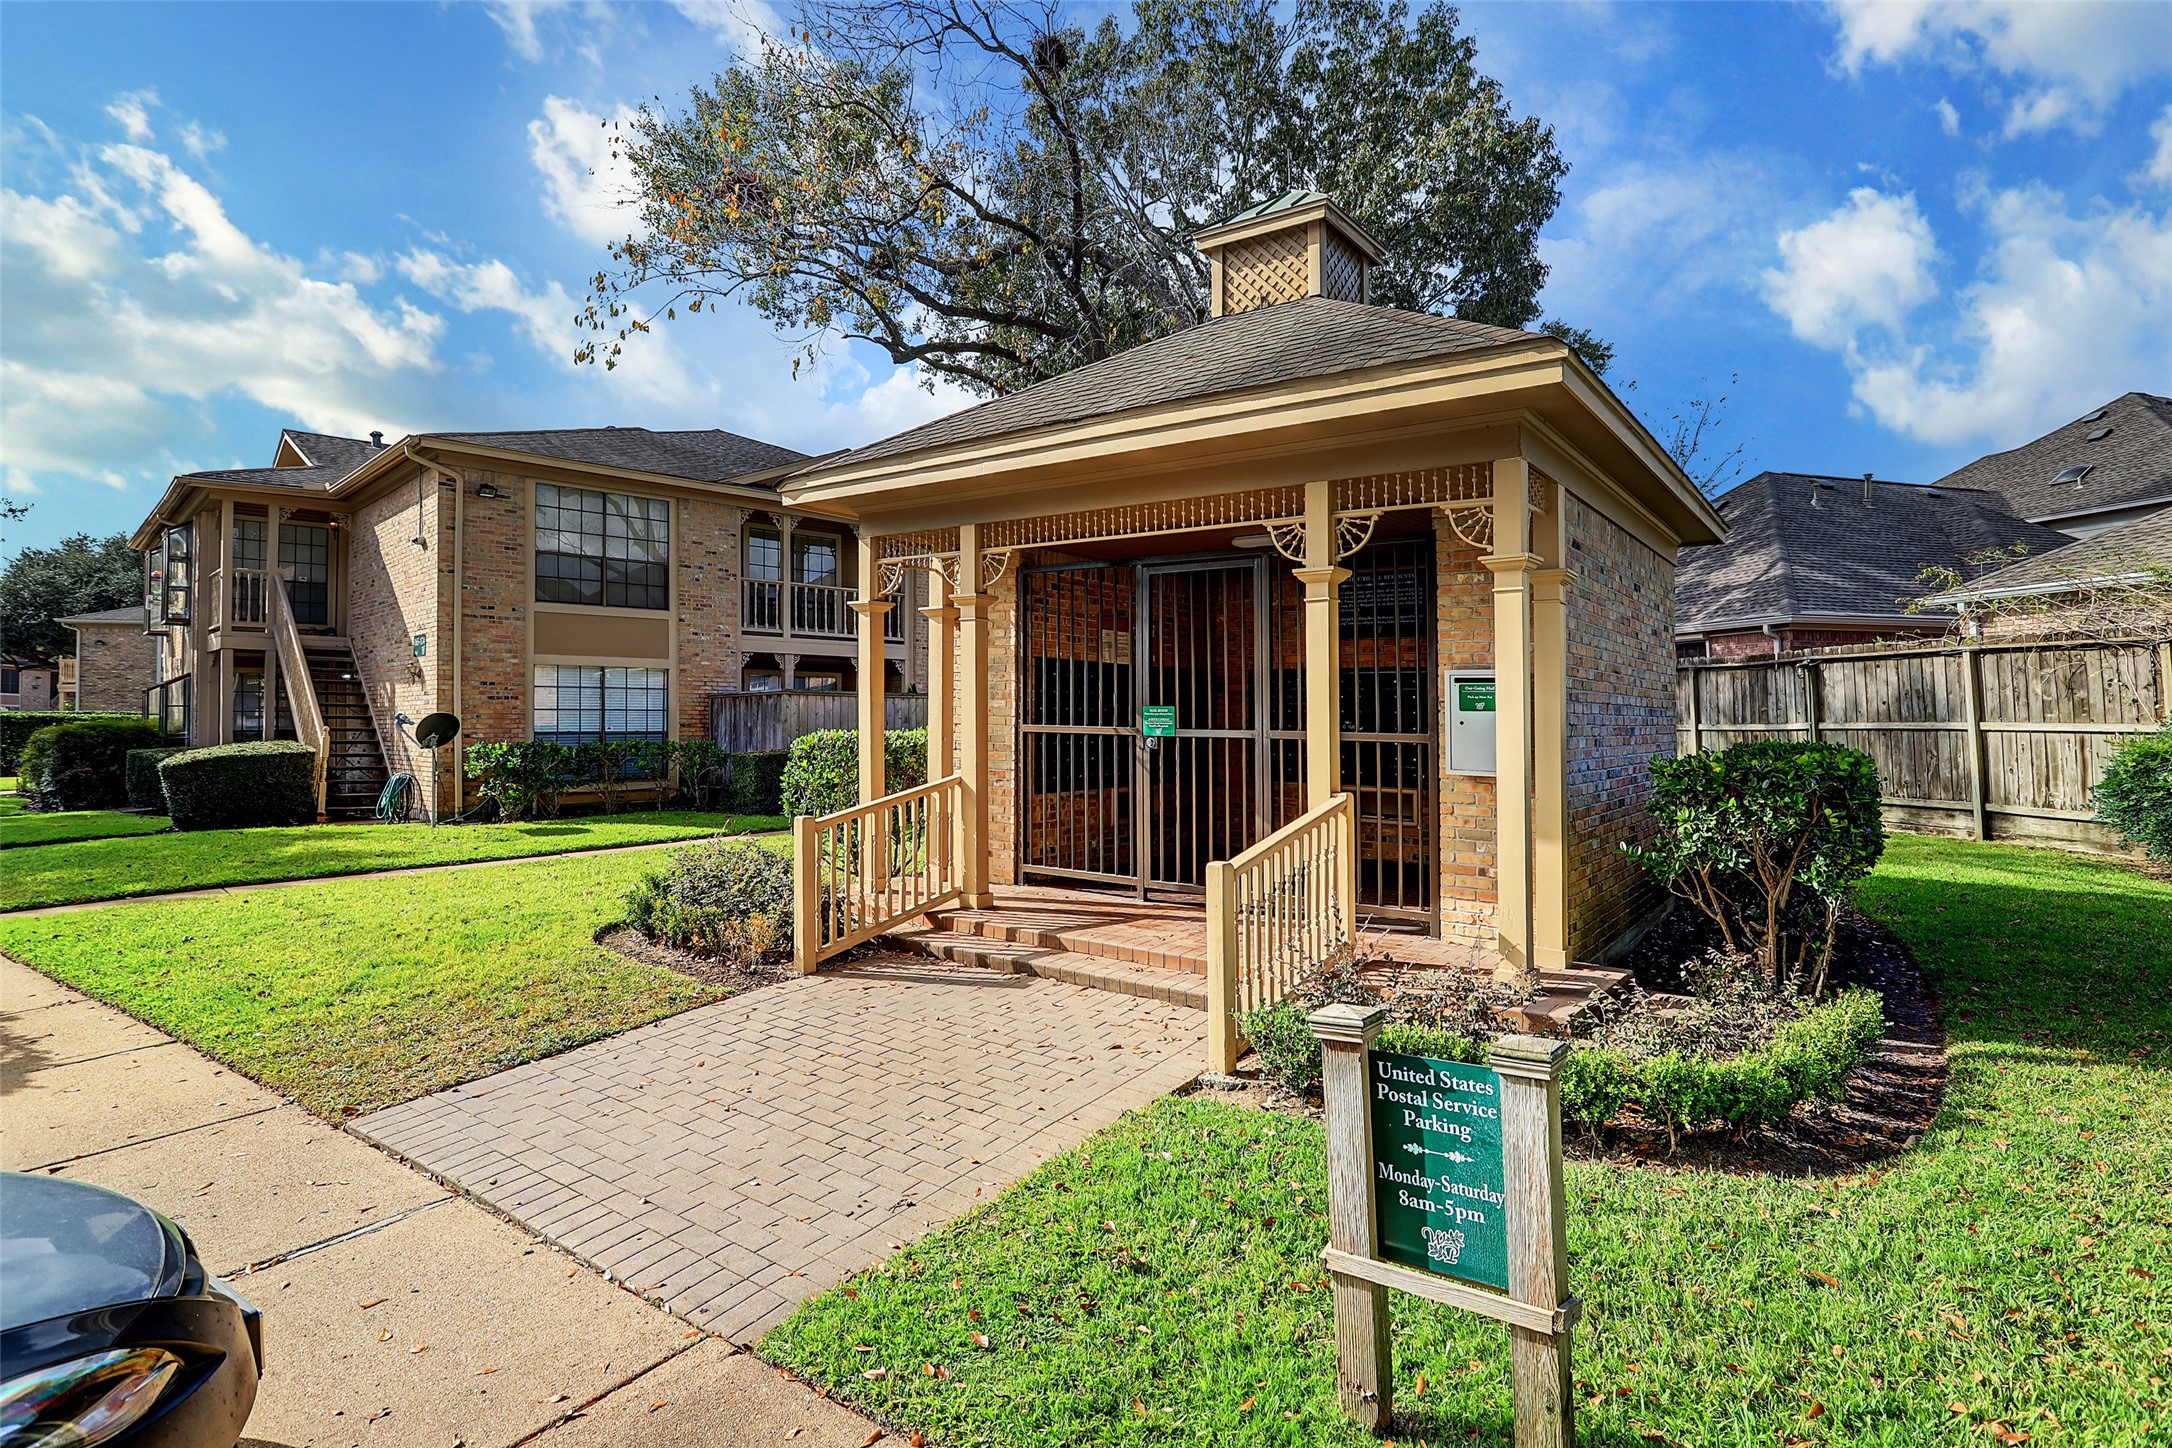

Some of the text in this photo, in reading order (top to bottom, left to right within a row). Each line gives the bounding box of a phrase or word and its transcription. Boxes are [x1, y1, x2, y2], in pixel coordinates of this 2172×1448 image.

[1377, 1061, 1494, 1095] United States
[1377, 1082, 1498, 1119] Postal Service
[1402, 1109, 1472, 1143] Parking
[1378, 1162, 1505, 1209] Monday-Saturday
[1398, 1190, 1486, 1224] 8am-5pm
